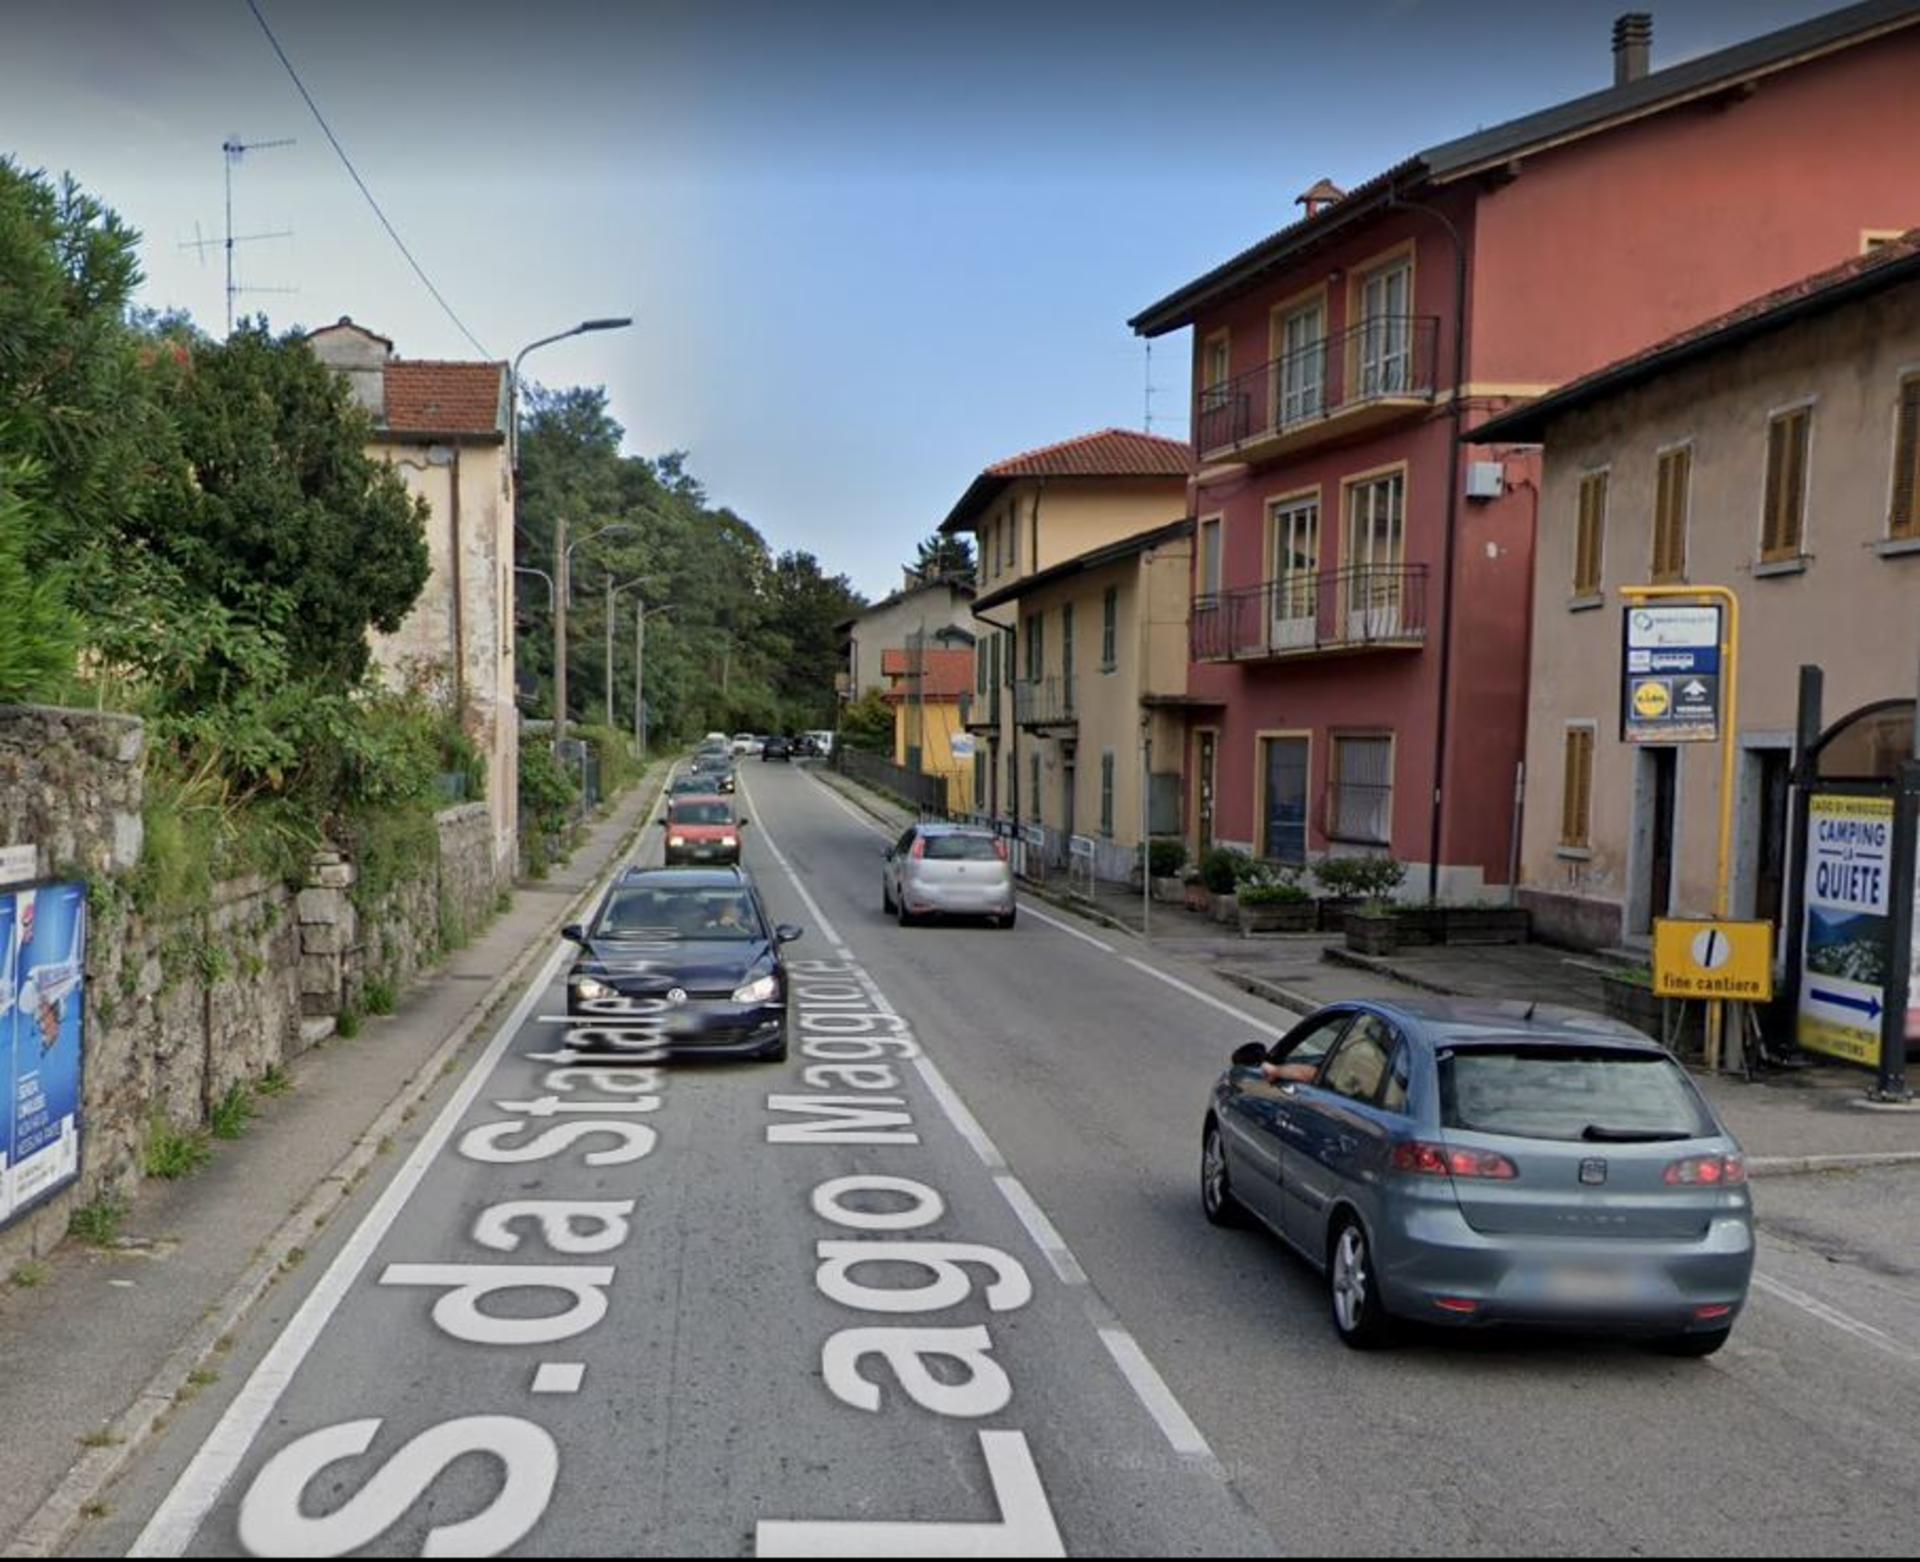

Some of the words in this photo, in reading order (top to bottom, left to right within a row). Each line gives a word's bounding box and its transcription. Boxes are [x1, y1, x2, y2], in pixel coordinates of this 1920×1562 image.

[1818, 819, 1885, 847] CAMPING
[1816, 861, 1881, 904] QUIETE
[1664, 974, 1692, 989] fine
[1696, 976, 1760, 993] cantiere
